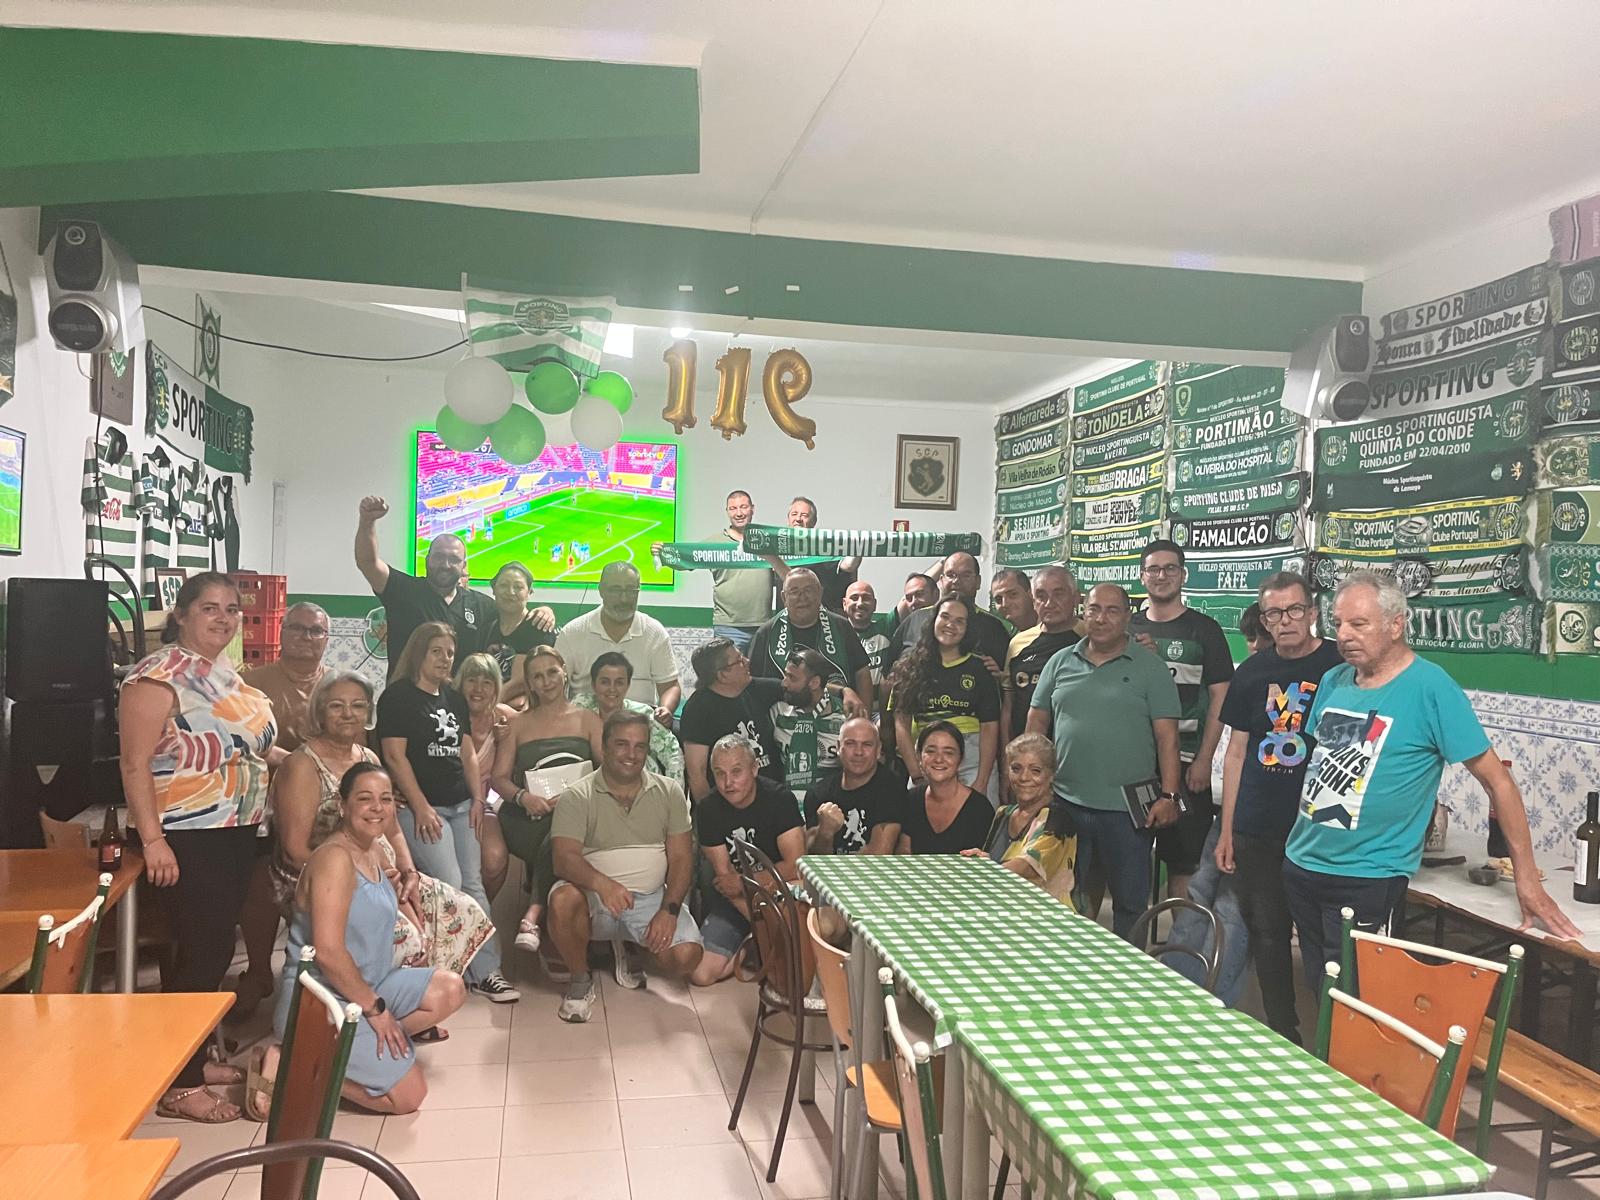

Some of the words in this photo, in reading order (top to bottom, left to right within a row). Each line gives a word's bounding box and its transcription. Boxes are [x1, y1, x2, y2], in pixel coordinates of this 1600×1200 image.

[520, 301, 564, 313] SPORTING
[1415, 278, 1517, 327] SPORTING
[1370, 357, 1496, 410] SPORTING
[172, 383, 232, 456] SPORTING
[1010, 400, 1055, 431] Alferrarede
[1088, 404, 1144, 436] TONDELA
[1195, 410, 1274, 444] PORTIMÃO
[1350, 423, 1392, 445] NÚCLEO
[1396, 404, 1493, 434] SPORTINGUISTA
[1012, 434, 1053, 456] GONDOMAR
[1359, 436, 1403, 458] QUINTA
[1406, 430, 1425, 447] DO
[1429, 423, 1474, 443] CONDE
[1104, 446, 1127, 460] AVEIRO
[1195, 462, 1226, 476] OLIVEIRA
[1226, 459, 1238, 472] DO
[1238, 452, 1273, 470] HOSPITAL
[1359, 453, 1401, 471] FUNDADO
[1404, 449, 1416, 461] EM
[1419, 441, 1471, 458] 22/04/2010
[1114, 465, 1146, 488] BRAGA
[1184, 491, 1218, 507] SPORTING
[1246, 486, 1259, 500] DE
[1260, 481, 1283, 498] NISA
[1014, 513, 1051, 531] SESIMBRA
[1354, 519, 1395, 536] SPORTING
[1432, 510, 1480, 528] SPORTING
[1192, 522, 1269, 547] FAMALICÃO
[1354, 537, 1370, 548] Clube
[1370, 536, 1394, 550] Portugal
[1432, 531, 1450, 543] Clube
[1450, 528, 1479, 543] Portugal
[693, 550, 732, 562] SPORTING
[1081, 542, 1094, 553] VILA
[1094, 541, 1109, 553] REAL
[1198, 561, 1218, 573] NÚCLEO
[1218, 561, 1263, 573] SPORTINGUISTA
[1263, 560, 1273, 569] DE
[1431, 554, 1499, 579] Portugal
[1217, 571, 1248, 590] FAFE
[1328, 747, 1370, 776] DAYS
[1318, 757, 1356, 797] GONE
